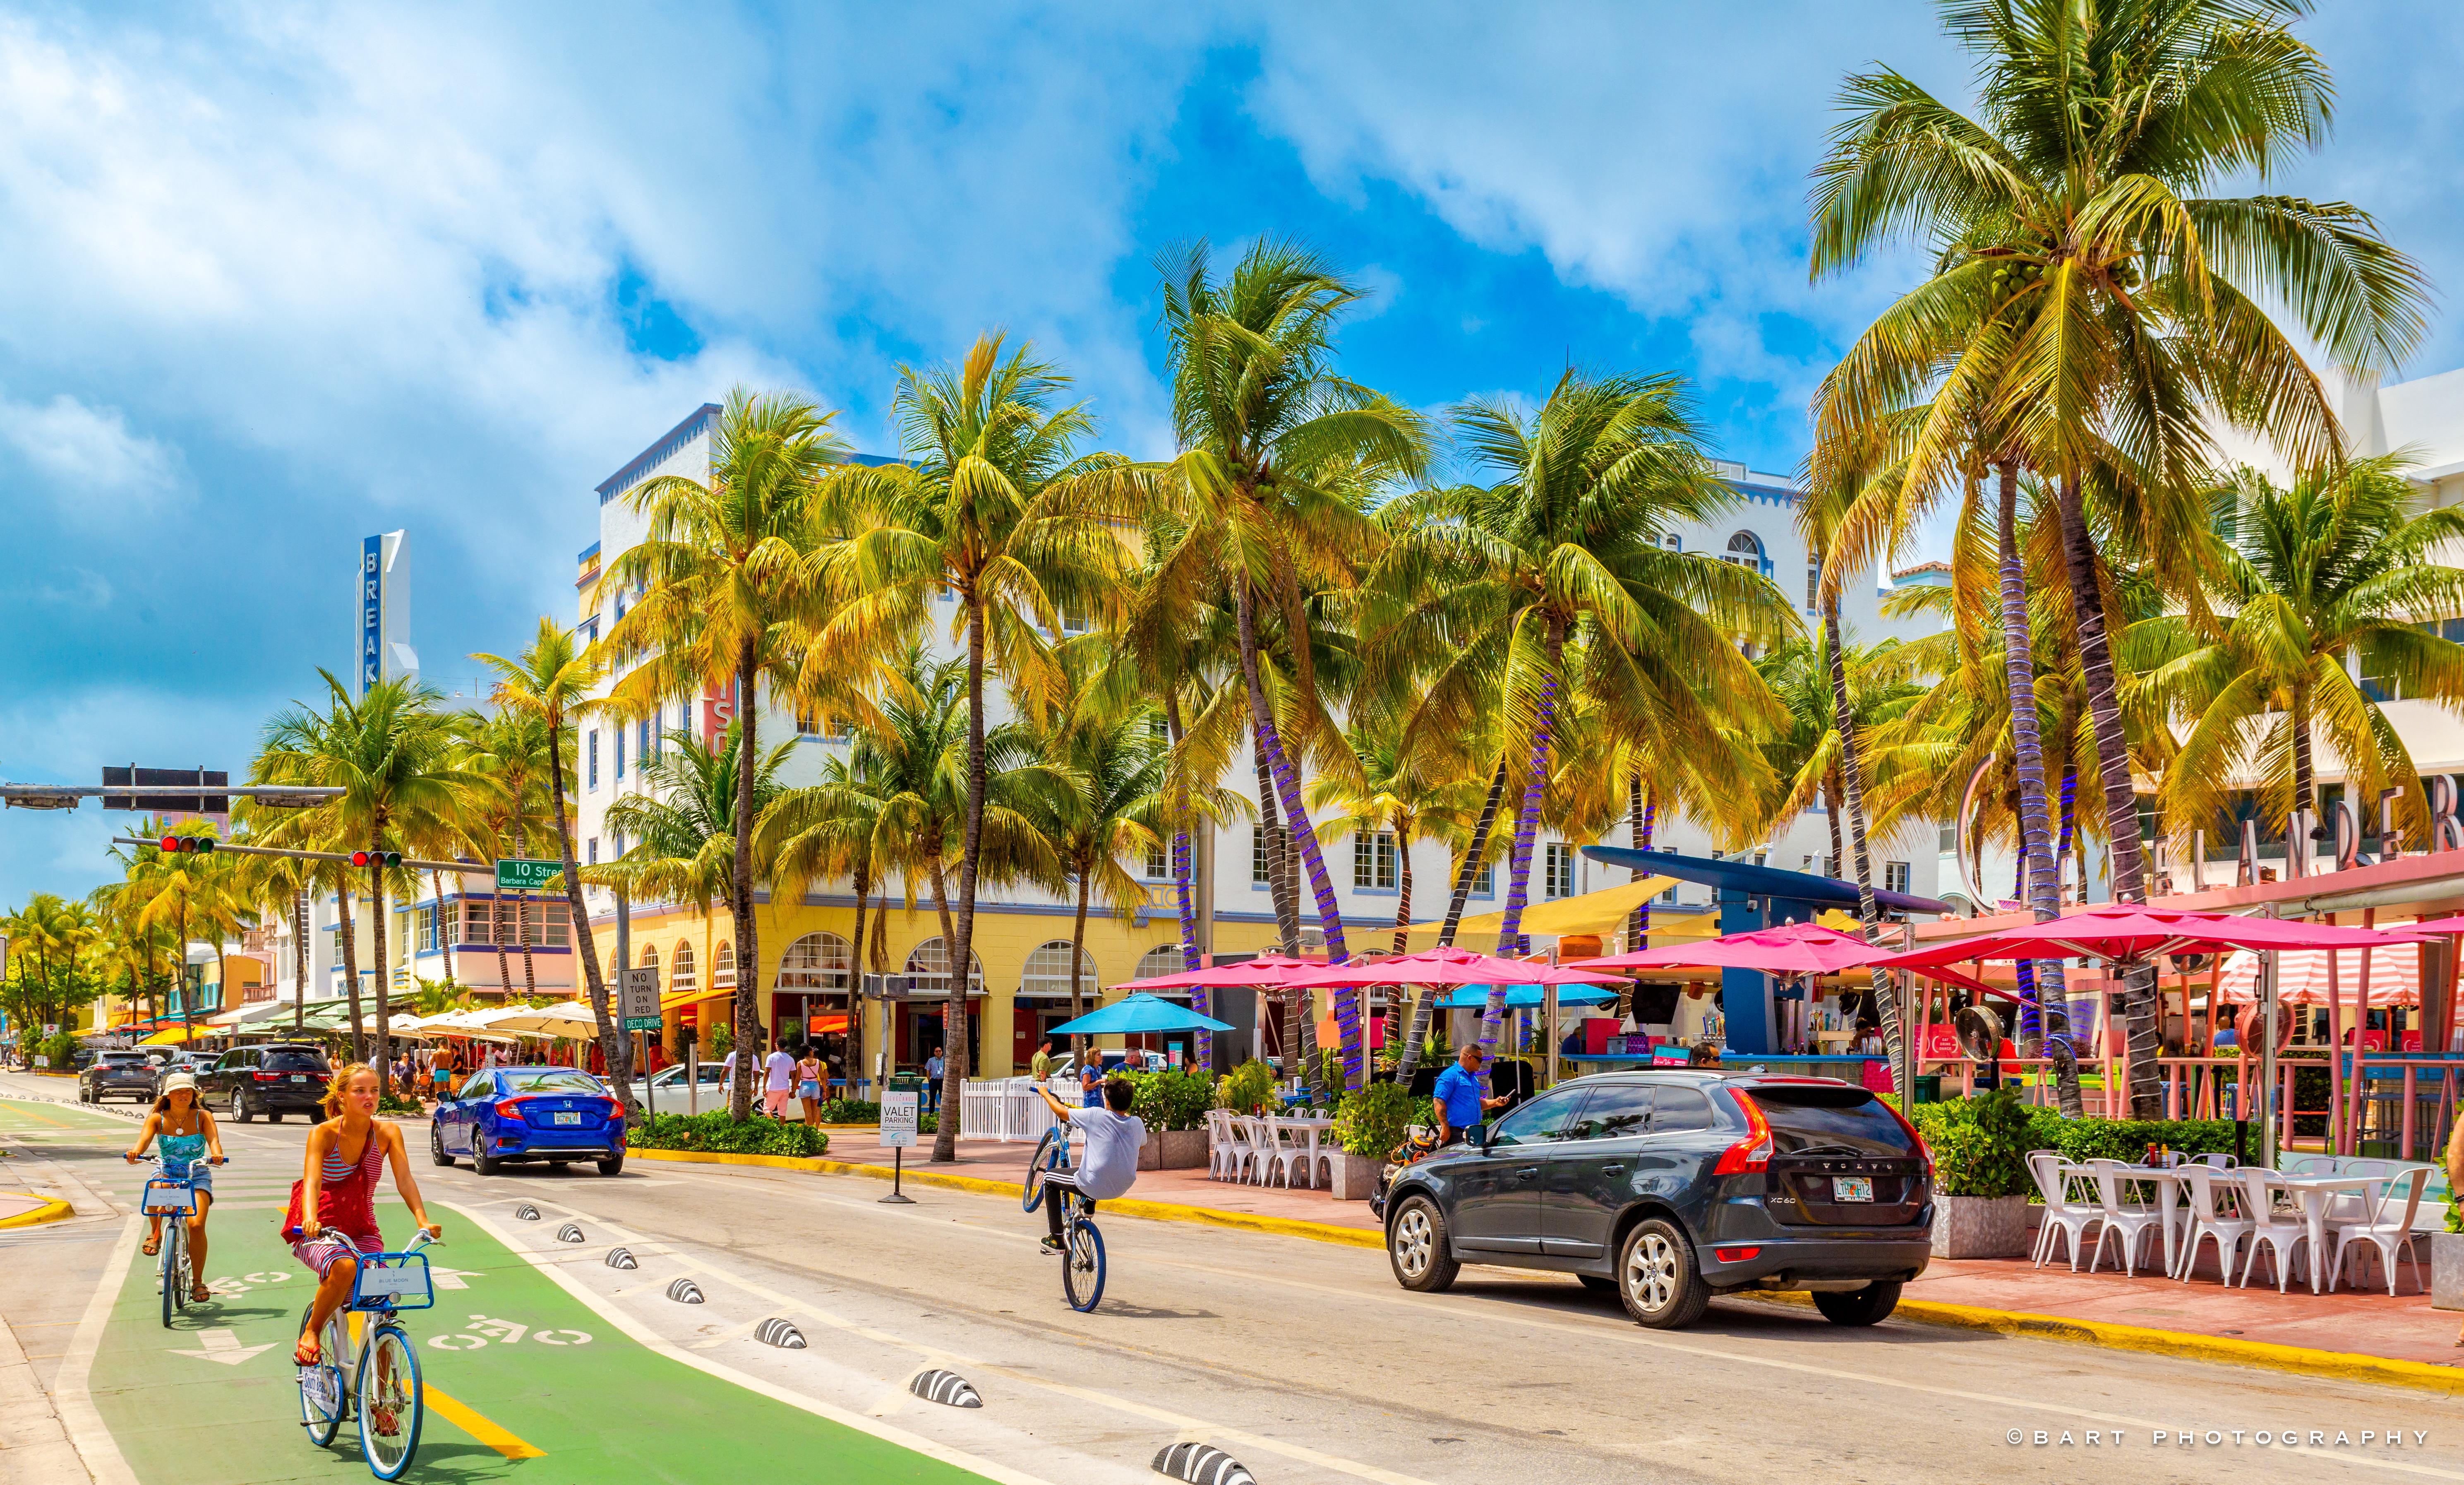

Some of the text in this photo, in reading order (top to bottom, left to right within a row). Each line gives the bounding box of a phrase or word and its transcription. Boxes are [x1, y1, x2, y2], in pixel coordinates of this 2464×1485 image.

[516, 863, 530, 876] 10
[632, 973, 647, 983] NO
[630, 985, 651, 993] TURN
[627, 1018, 661, 1028] DECO DRIVE
[2272, 1047, 2275, 1057] 1
[884, 1106, 915, 1116] VALET
